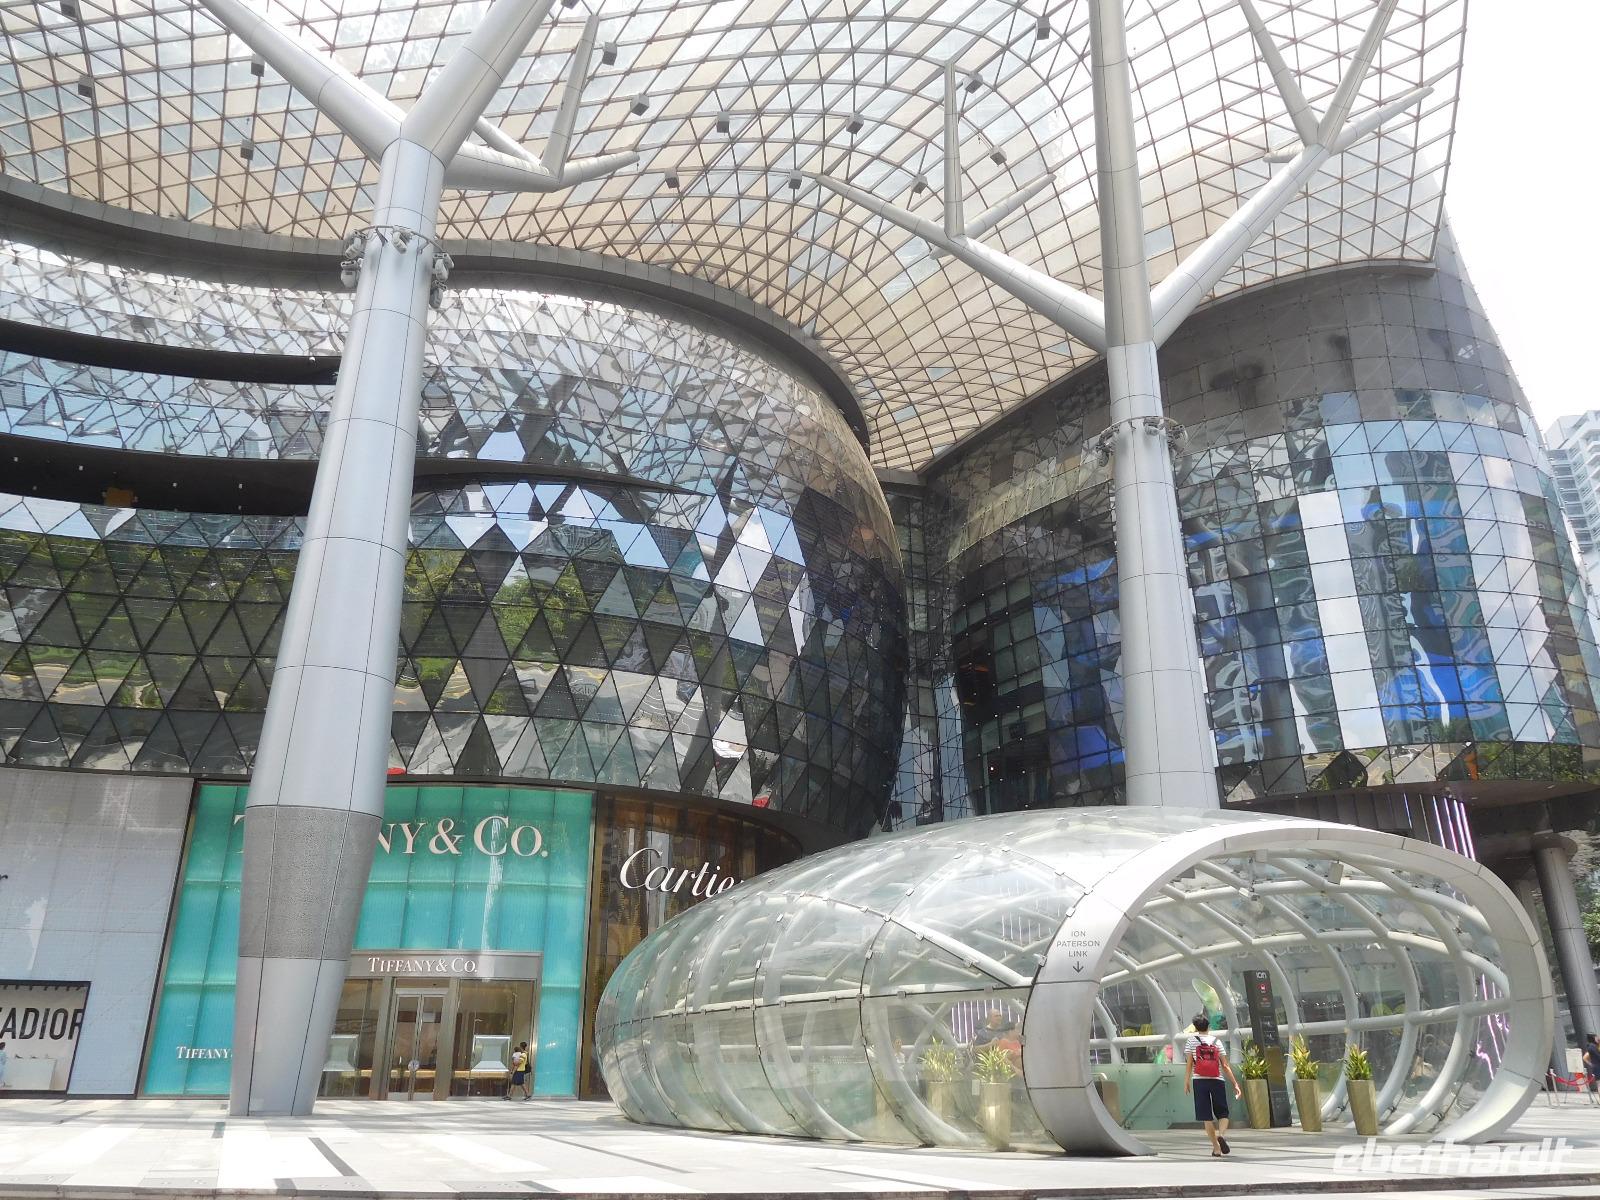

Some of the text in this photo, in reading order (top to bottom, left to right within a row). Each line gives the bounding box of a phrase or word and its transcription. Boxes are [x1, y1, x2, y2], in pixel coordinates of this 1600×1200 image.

[620, 847, 745, 898] Cartie
[1071, 930, 1086, 938] ION
[1056, 940, 1101, 948] PATERSON
[1068, 950, 1088, 958] LINK
[0, 1007, 84, 1040] ADIOR
